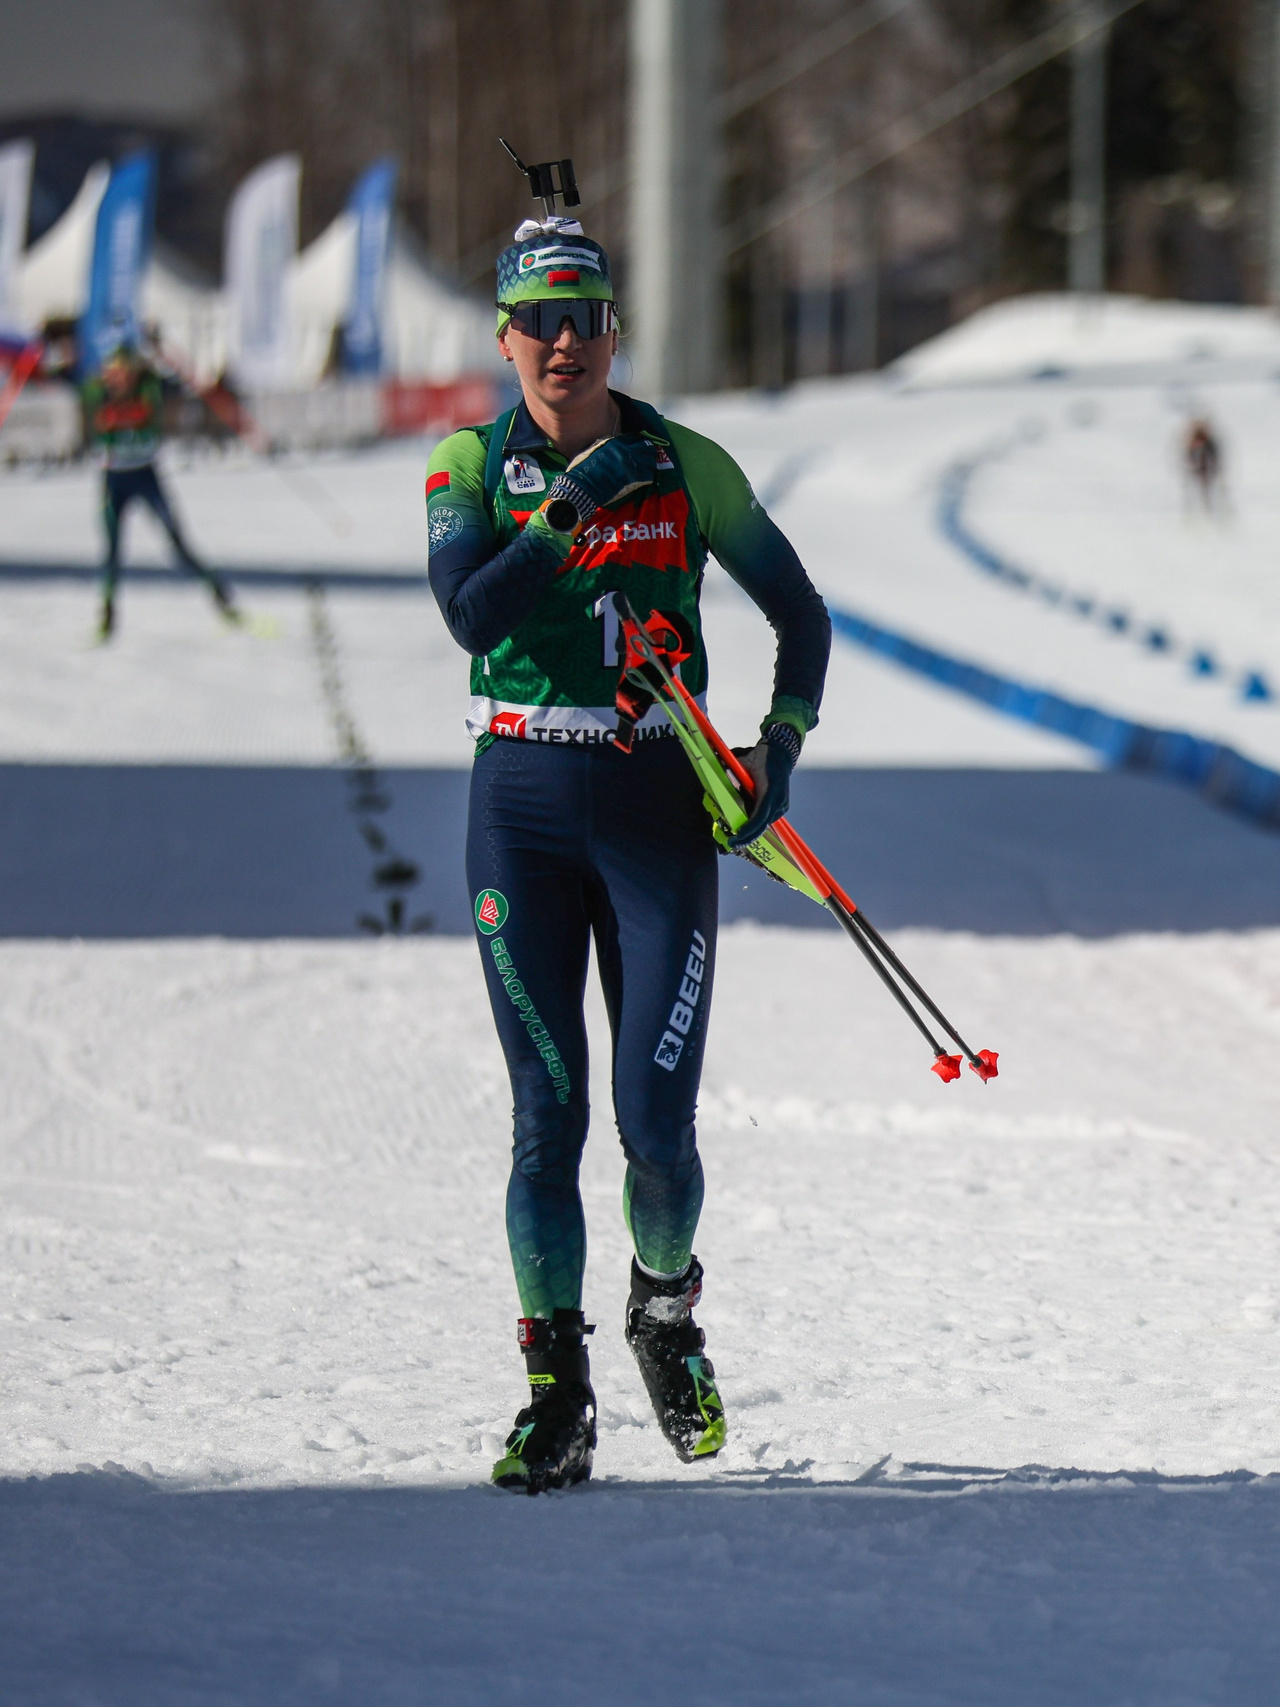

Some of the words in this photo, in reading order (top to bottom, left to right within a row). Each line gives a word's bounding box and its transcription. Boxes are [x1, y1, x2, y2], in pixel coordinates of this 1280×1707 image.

[623, 520, 679, 542] Банк
[594, 590, 620, 667] 1
[749, 840, 775, 862] FISCHE
[491, 937, 571, 1104] БЕЛОРУСНЕФТЬ
